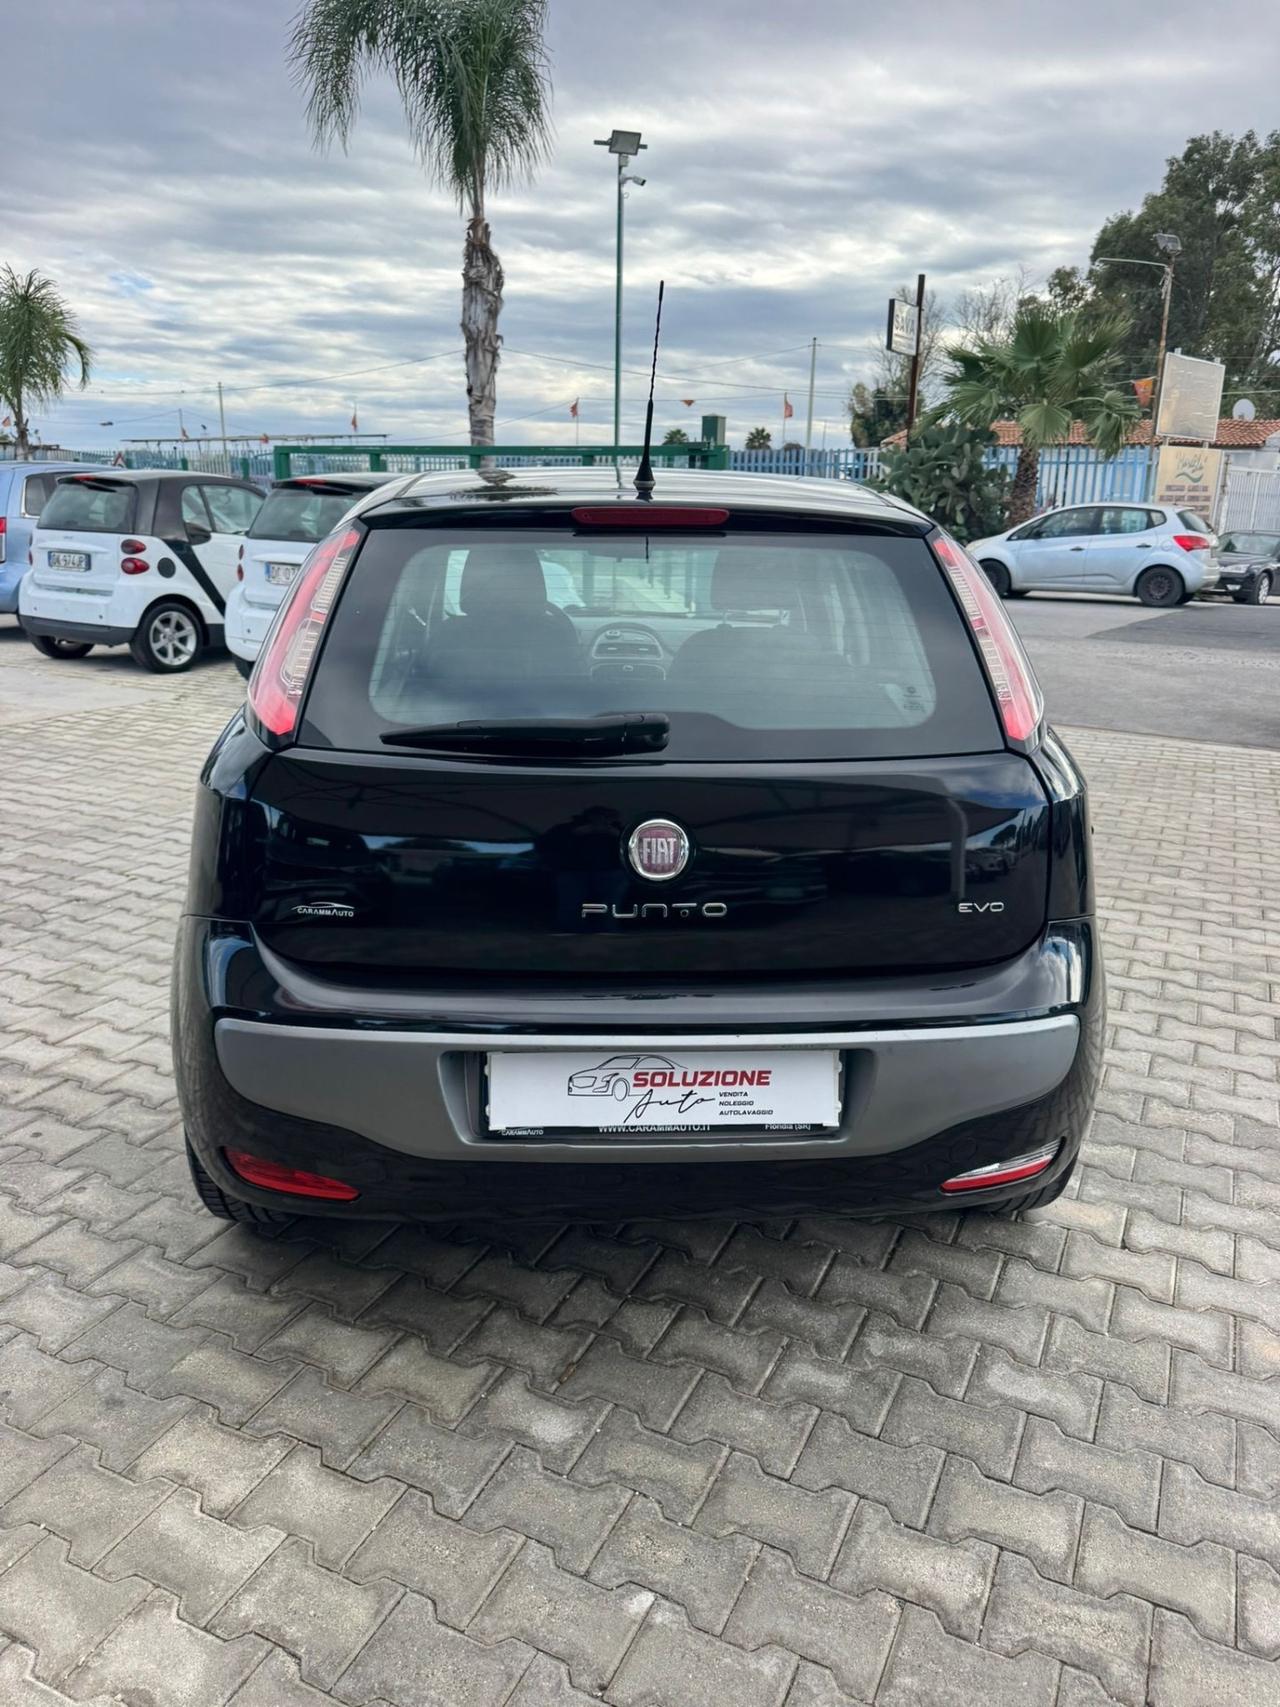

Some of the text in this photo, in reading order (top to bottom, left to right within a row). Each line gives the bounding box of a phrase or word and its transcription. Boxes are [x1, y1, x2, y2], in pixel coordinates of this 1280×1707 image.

[642, 837, 677, 864] FIAT
[581, 902, 728, 919] PUNTO
[958, 901, 1005, 913] EVO
[633, 1070, 772, 1088] SOLUZIONE
[623, 1088, 716, 1124] Auto
[718, 1109, 774, 1117] AUTOLAVAGGIO
